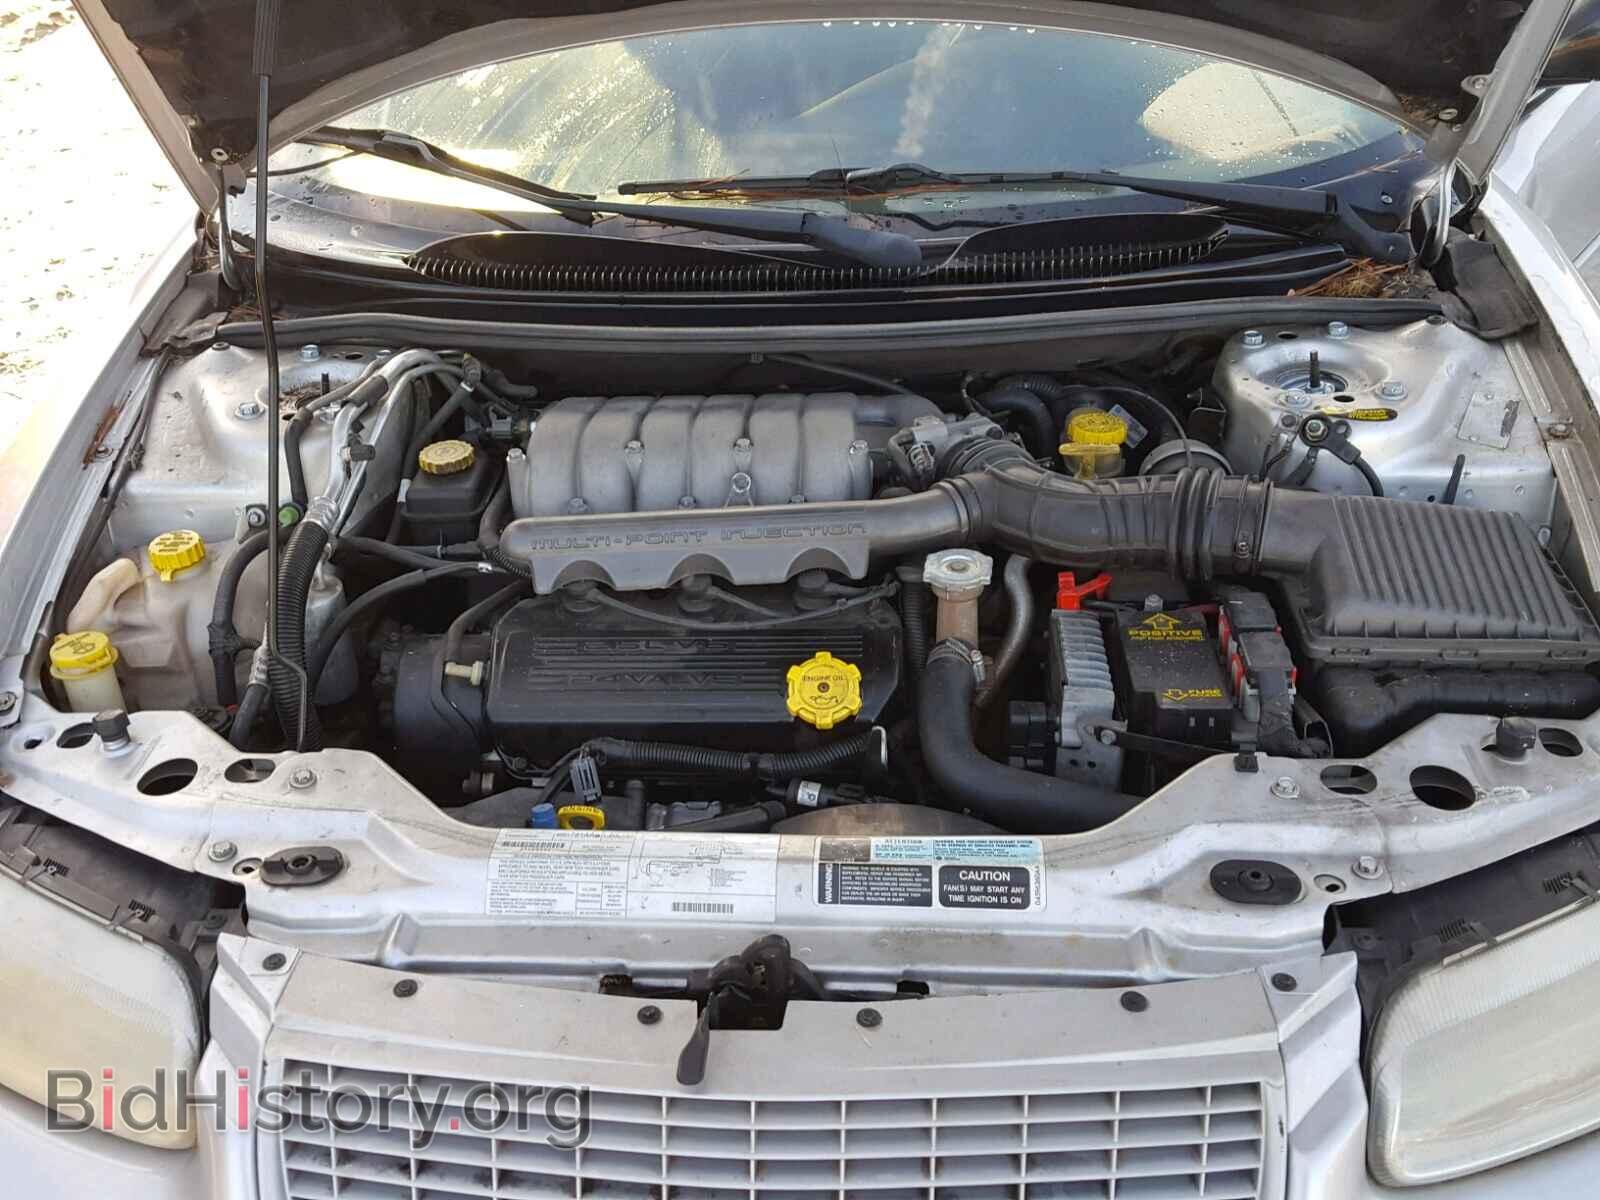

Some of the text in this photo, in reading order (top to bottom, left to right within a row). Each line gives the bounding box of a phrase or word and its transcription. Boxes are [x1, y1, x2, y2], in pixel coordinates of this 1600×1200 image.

[719, 522, 866, 541] INJECTION
[1128, 629, 1202, 637] POSITIVE
[801, 674, 831, 682] ENGINE
[959, 870, 1011, 881] CAUTION
[824, 863, 833, 903] WARNING
[943, 884, 968, 892] FAN(S)
[969, 885, 984, 893] MAY
[987, 886, 1009, 894] START
[948, 894, 1022, 904] TIME IGNITION IS ON
